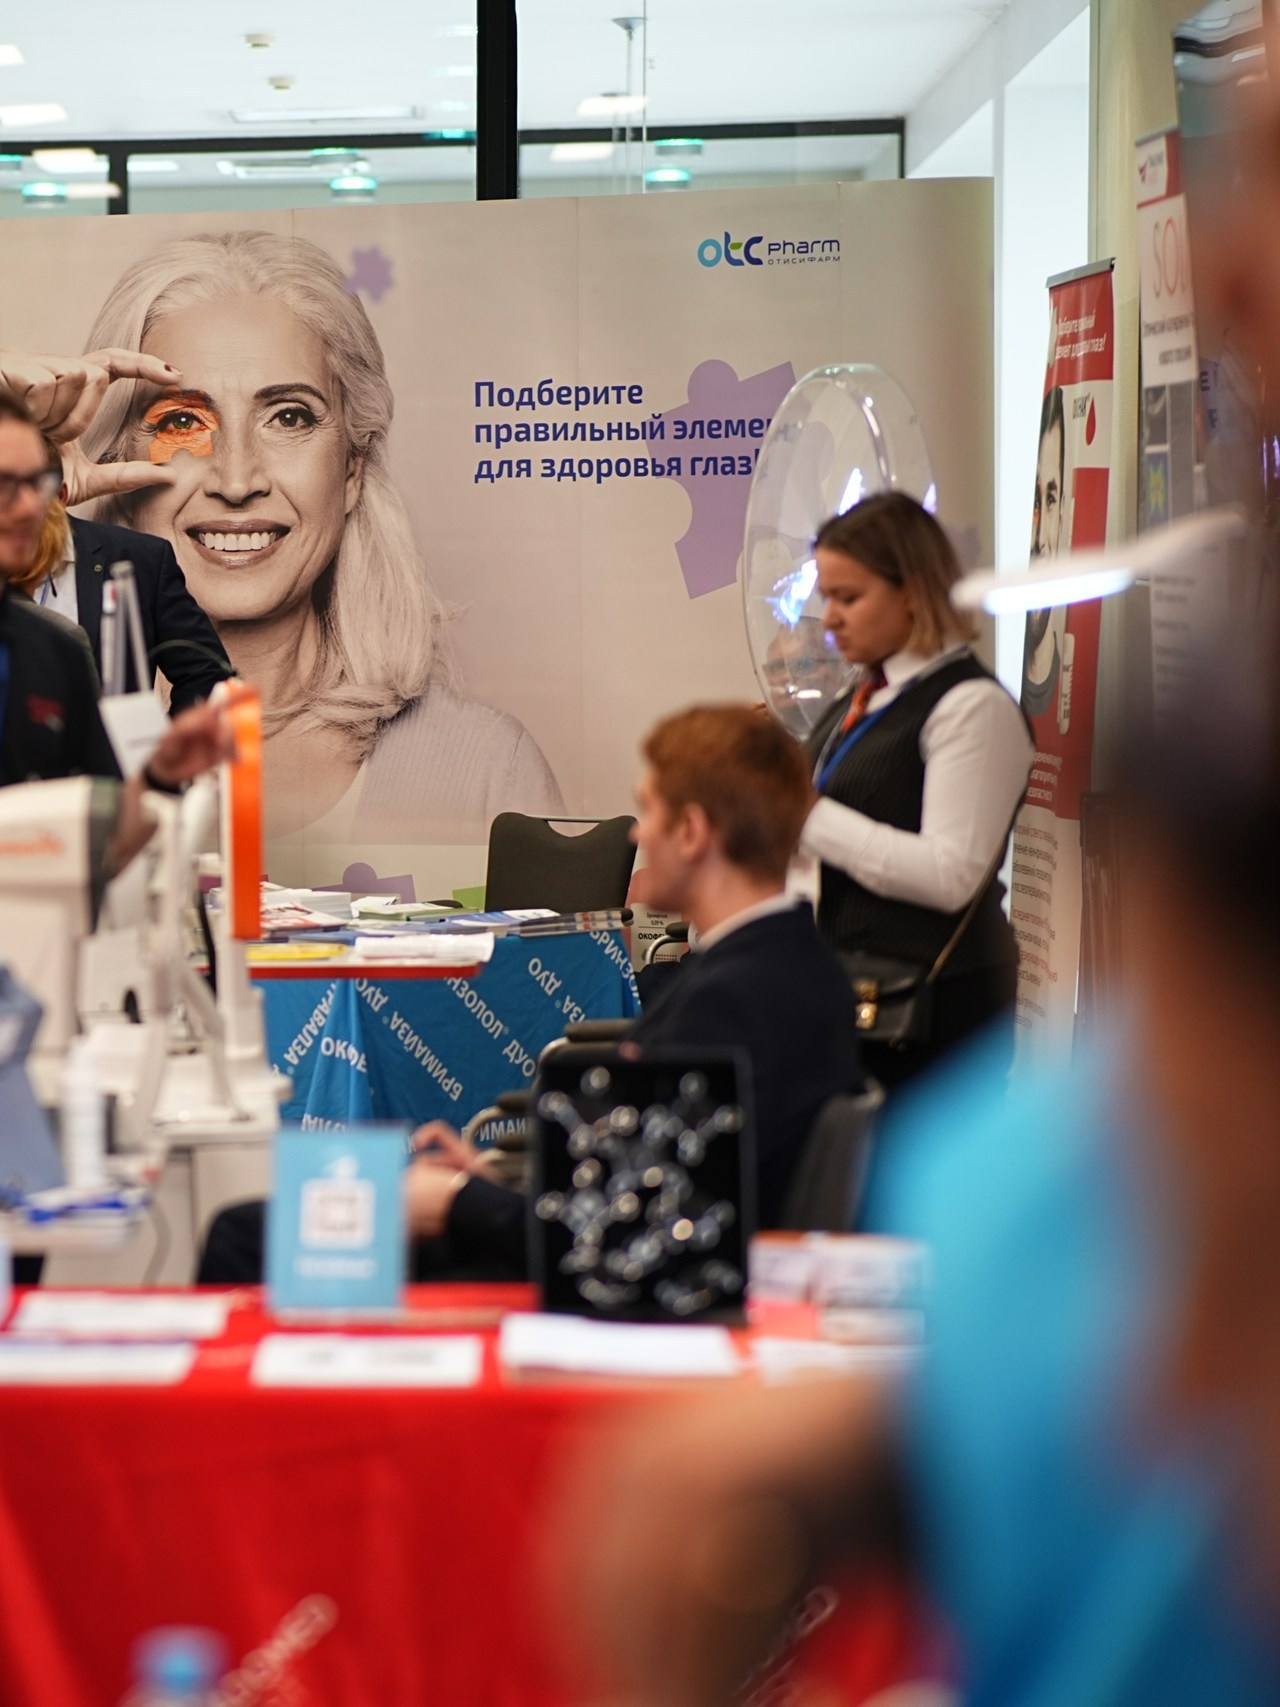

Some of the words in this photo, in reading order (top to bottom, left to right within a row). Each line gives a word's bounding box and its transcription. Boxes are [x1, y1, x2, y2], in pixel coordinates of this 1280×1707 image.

[768, 255, 841, 266] ОТИСИФАРМ
[475, 378, 643, 411] Подберите
[475, 413, 665, 449] правильный
[474, 458, 532, 483] для
[541, 457, 682, 484] здоровья
[528, 958, 562, 996] ДУО
[355, 978, 389, 1012] ДУО
[389, 1011, 464, 1101] БРИМАЙЗА
[502, 1039, 536, 1077] ДУО
